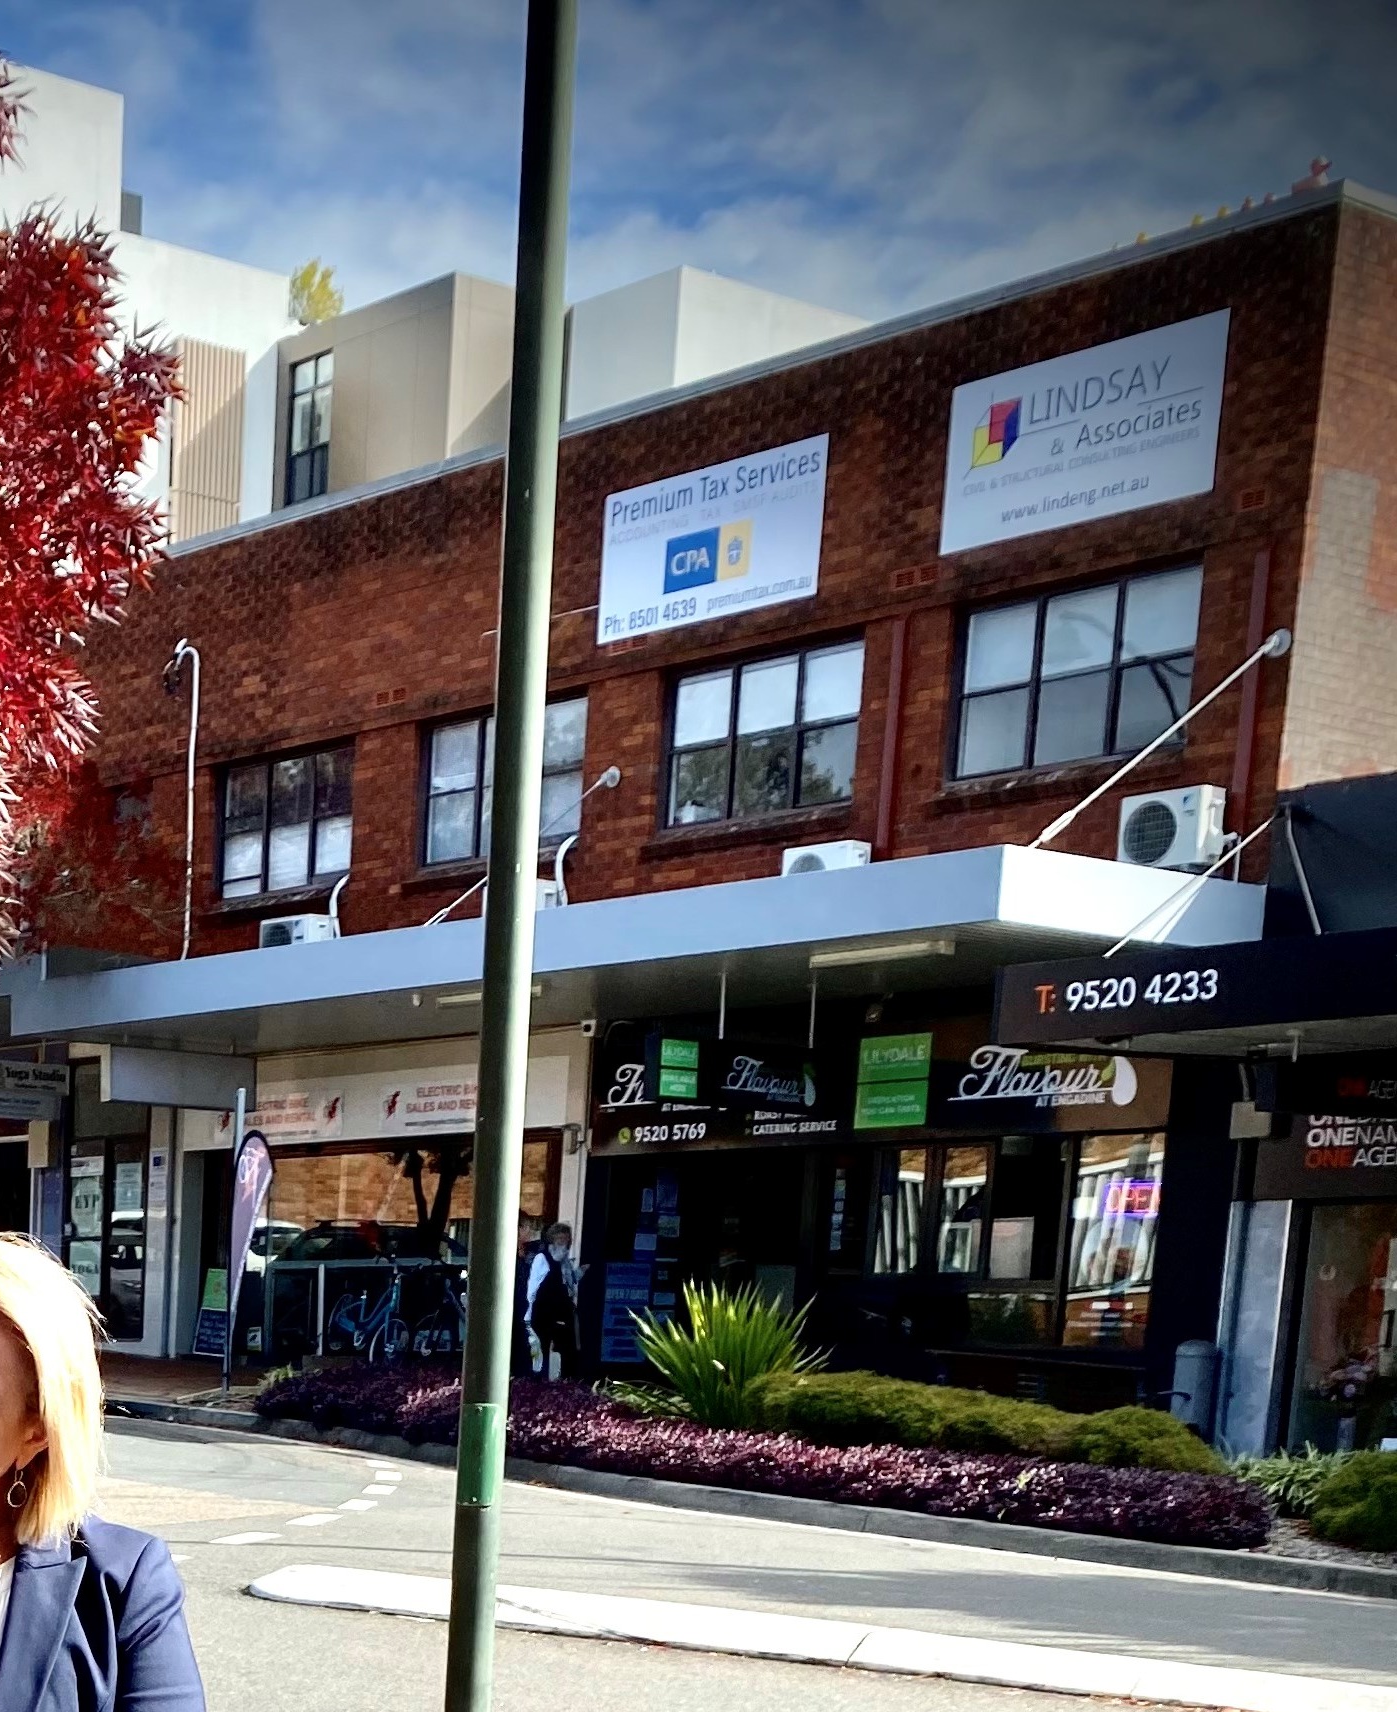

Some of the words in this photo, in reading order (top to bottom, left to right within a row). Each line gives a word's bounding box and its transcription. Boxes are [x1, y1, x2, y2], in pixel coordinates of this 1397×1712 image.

[1029, 356, 1171, 425] LINDSAY
[1050, 438, 1064, 456] &
[1076, 400, 1201, 449] Associates
[1001, 462, 1064, 487] STRUCTURAL
[1068, 441, 1136, 470] CONSULTING
[1139, 426, 1201, 451] ENGINEERS
[611, 486, 693, 527] Premium
[700, 476, 729, 502] Tax
[736, 451, 821, 493] Services
[1001, 476, 1150, 523] www.lindeng.net.au
[610, 513, 689, 545] ACCOUNTING
[701, 508, 721, 521] TAX
[670, 547, 710, 577] CPA
[605, 617, 624, 636] Ph:
[629, 608, 658, 631] 8501
[662, 597, 697, 621] 4639
[1034, 983, 1056, 1015] T:
[1065, 976, 1136, 1012] 9520
[1144, 969, 1219, 1006] 4233
[959, 1045, 1105, 1098] Flavour
[406, 1101, 435, 1113] SALES
[437, 1099, 457, 1111] AND
[416, 1084, 462, 1098] ELECTRIC
[1035, 1095, 1050, 1107] AT
[634, 1127, 668, 1143] 9520
[672, 1122, 706, 1140] 5769
[753, 1123, 797, 1136] CATERING
[798, 1120, 837, 1133] SERVICE
[1305, 1146, 1397, 1169] ONEAGE
